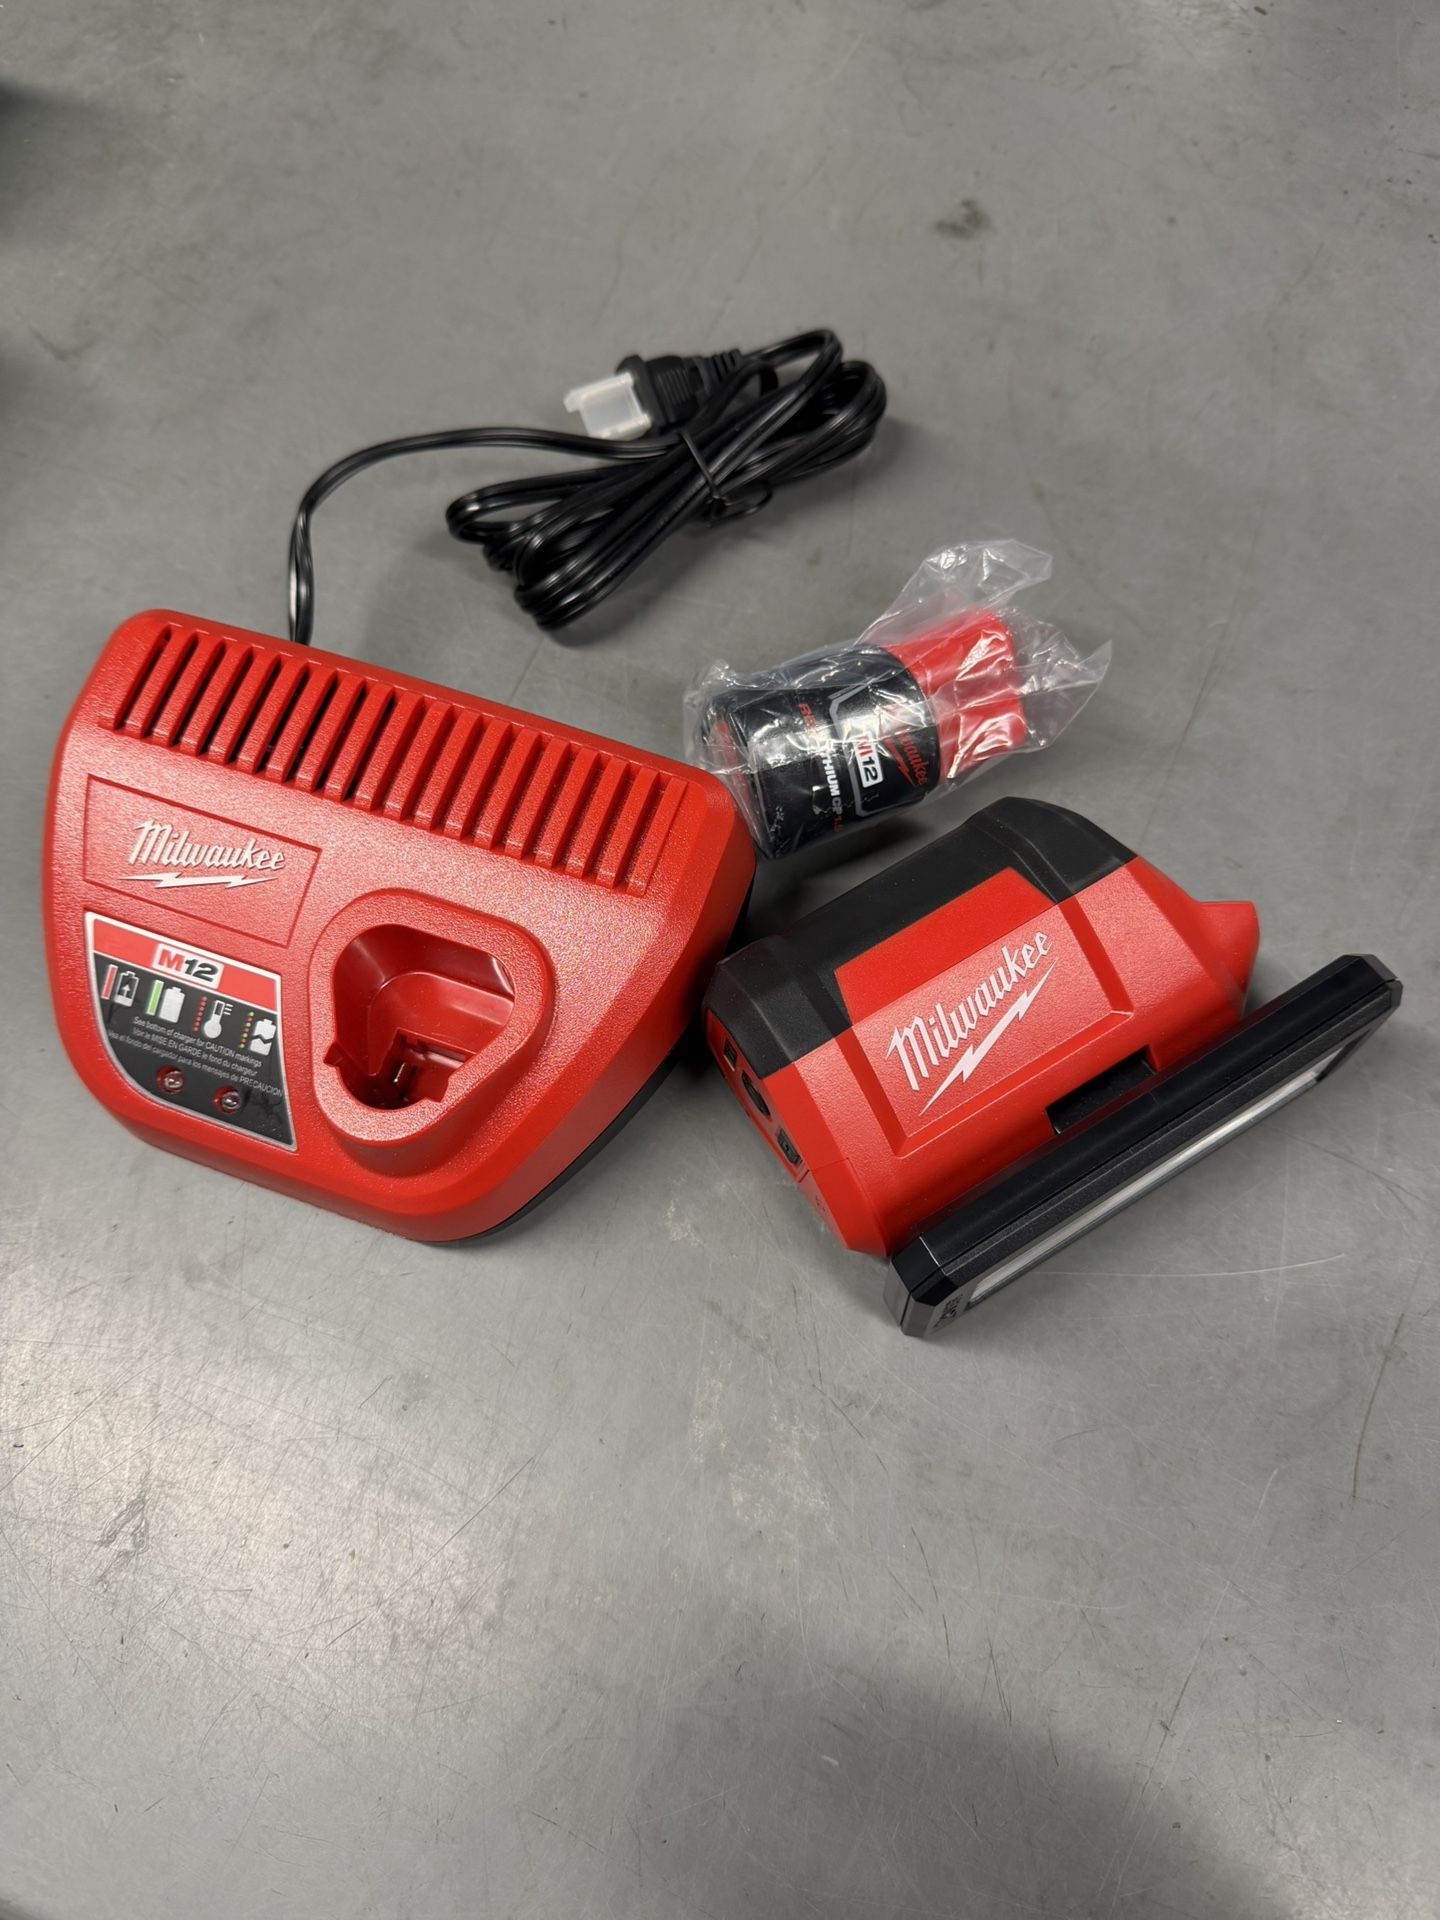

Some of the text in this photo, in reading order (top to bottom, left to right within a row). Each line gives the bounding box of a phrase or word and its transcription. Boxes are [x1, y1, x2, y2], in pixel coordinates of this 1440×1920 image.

[128, 820, 285, 871] Milwaukee
[158, 950, 219, 983] M12
[886, 931, 1053, 1091] Milwaukee
[133, 1016, 262, 1068] See bottom of charger for CAUTION markings
[152, 1034, 168, 1046] MISE
[168, 1039, 178, 1049] EN
[178, 1043, 202, 1058] GARDE
[208, 1054, 222, 1065] fond
[222, 1060, 231, 1068] du
[231, 1063, 258, 1077] chargeur
